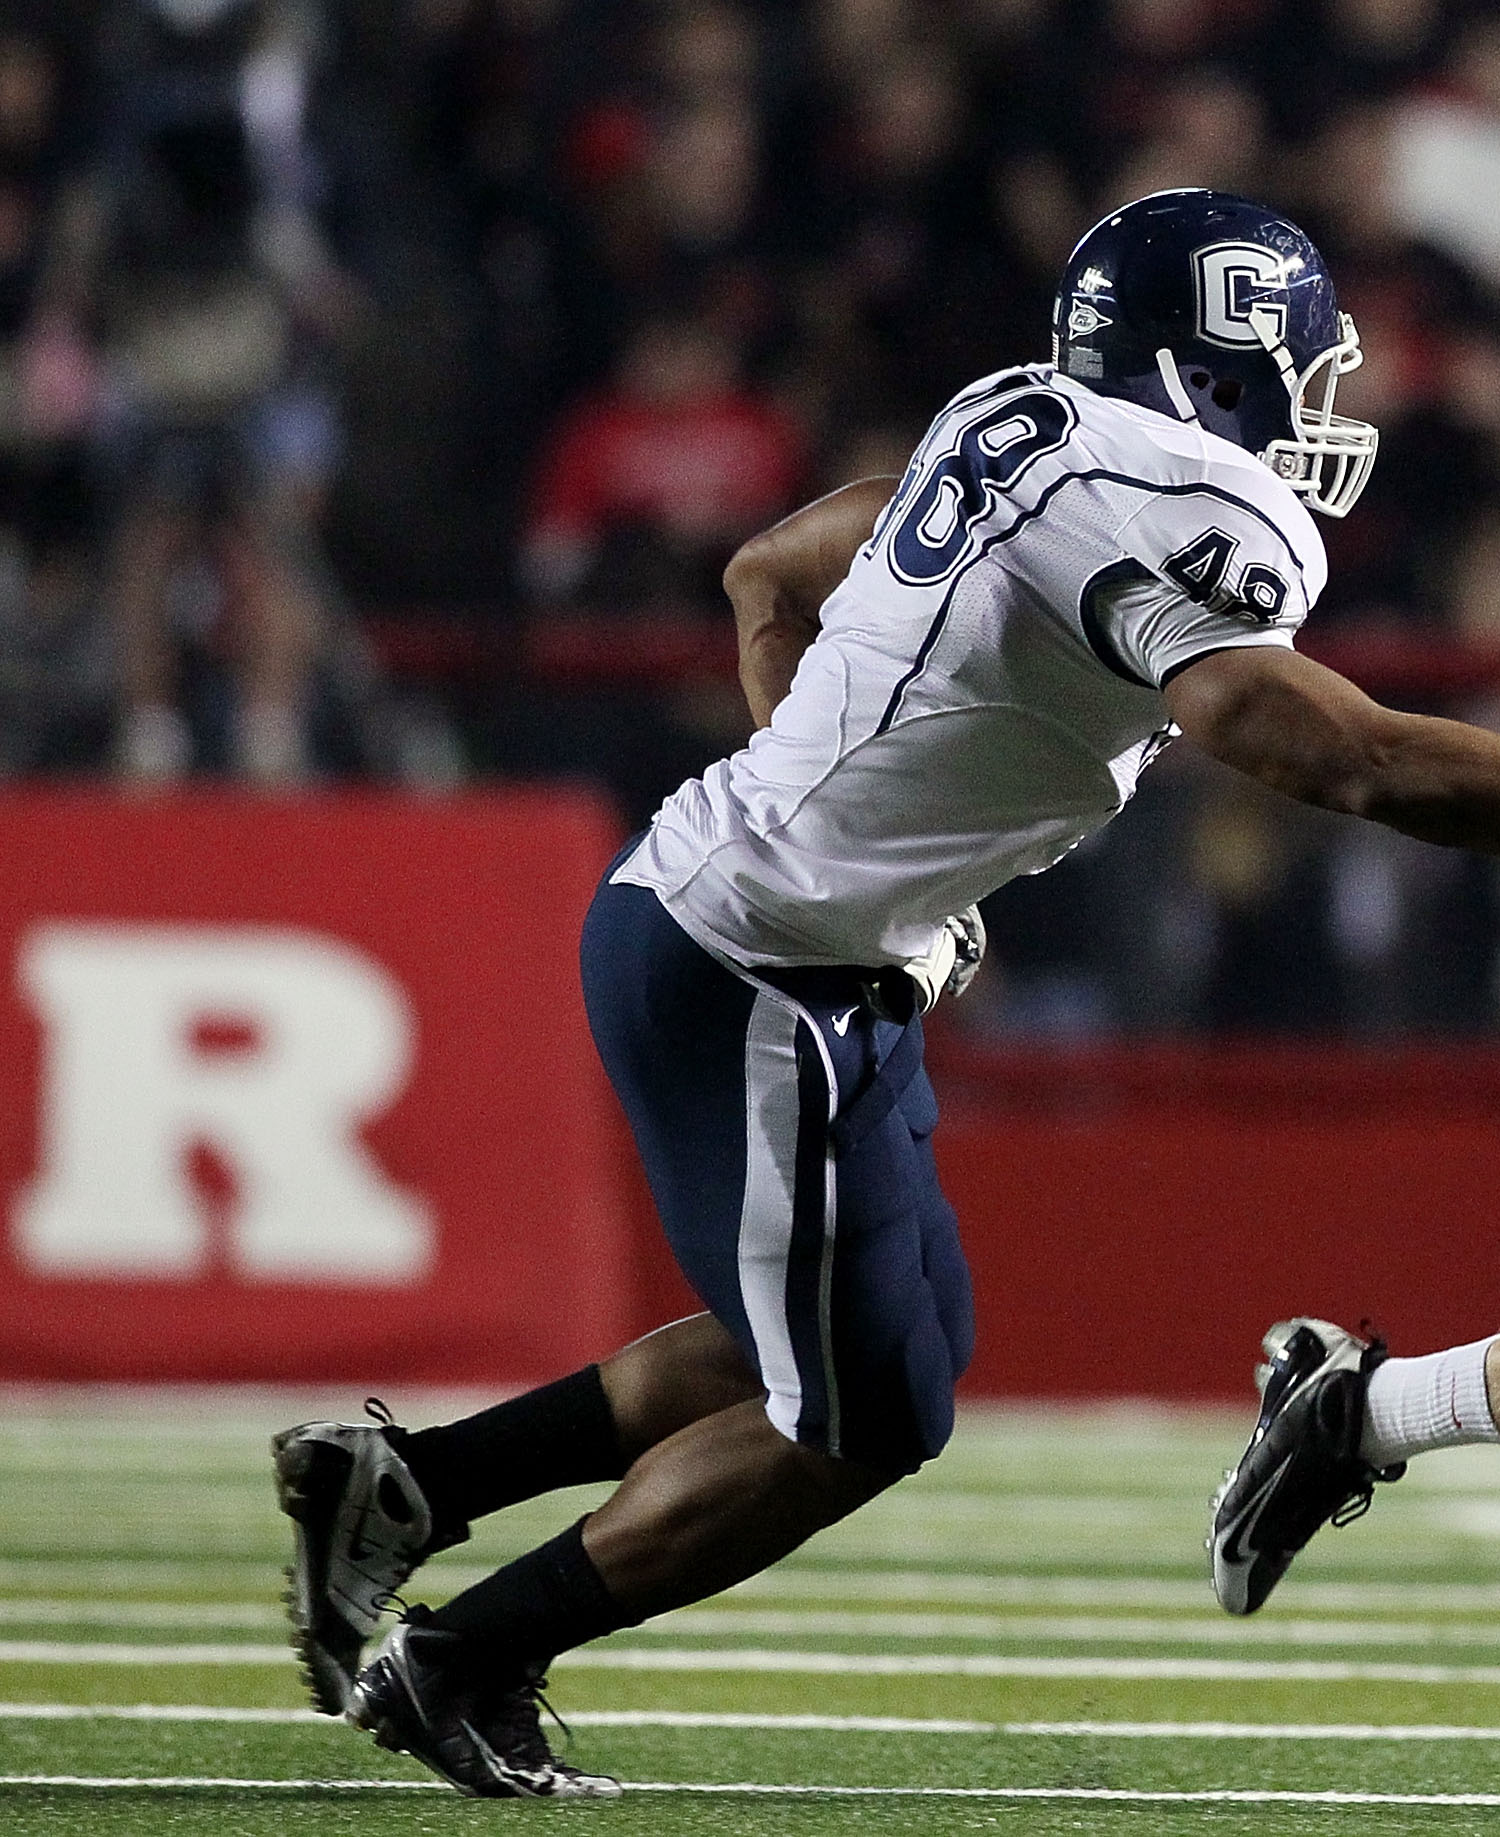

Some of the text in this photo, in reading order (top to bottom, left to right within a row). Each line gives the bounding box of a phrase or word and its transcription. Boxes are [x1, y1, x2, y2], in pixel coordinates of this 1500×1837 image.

[1189, 240, 1289, 351] C
[1158, 525, 1291, 625] 48
[14, 924, 434, 1278] R
